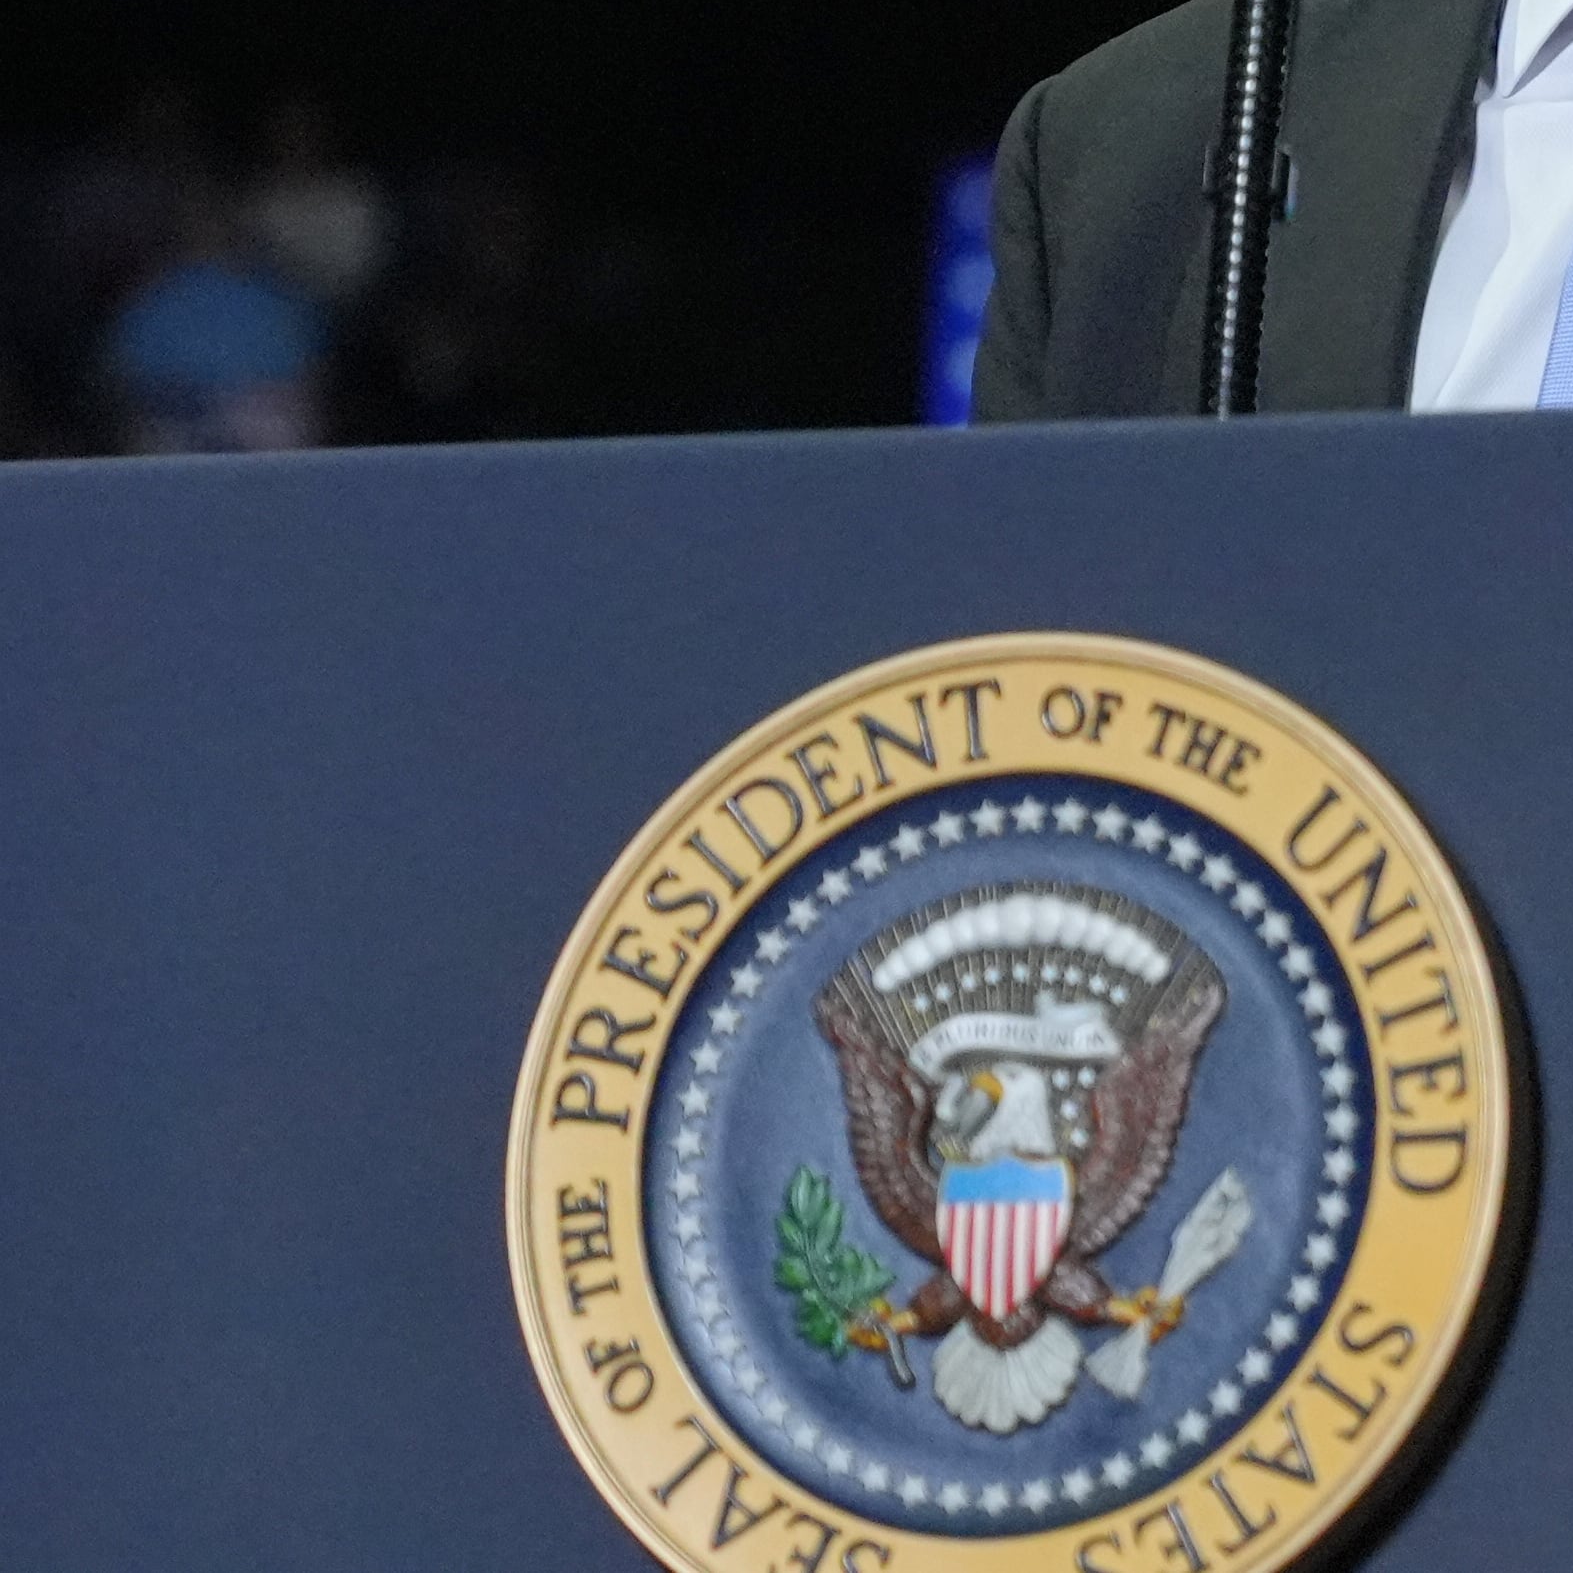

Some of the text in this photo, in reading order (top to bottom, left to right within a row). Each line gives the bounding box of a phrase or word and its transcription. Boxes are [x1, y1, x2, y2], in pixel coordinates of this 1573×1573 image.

[1040, 685, 1122, 743] OF
[1147, 704, 1262, 797] THE
[550, 677, 1003, 1134] PRESIDENT
[1284, 784, 1467, 1197] UNITED
[557, 1177, 619, 1315] THE
[583, 1337, 655, 1414] OF
